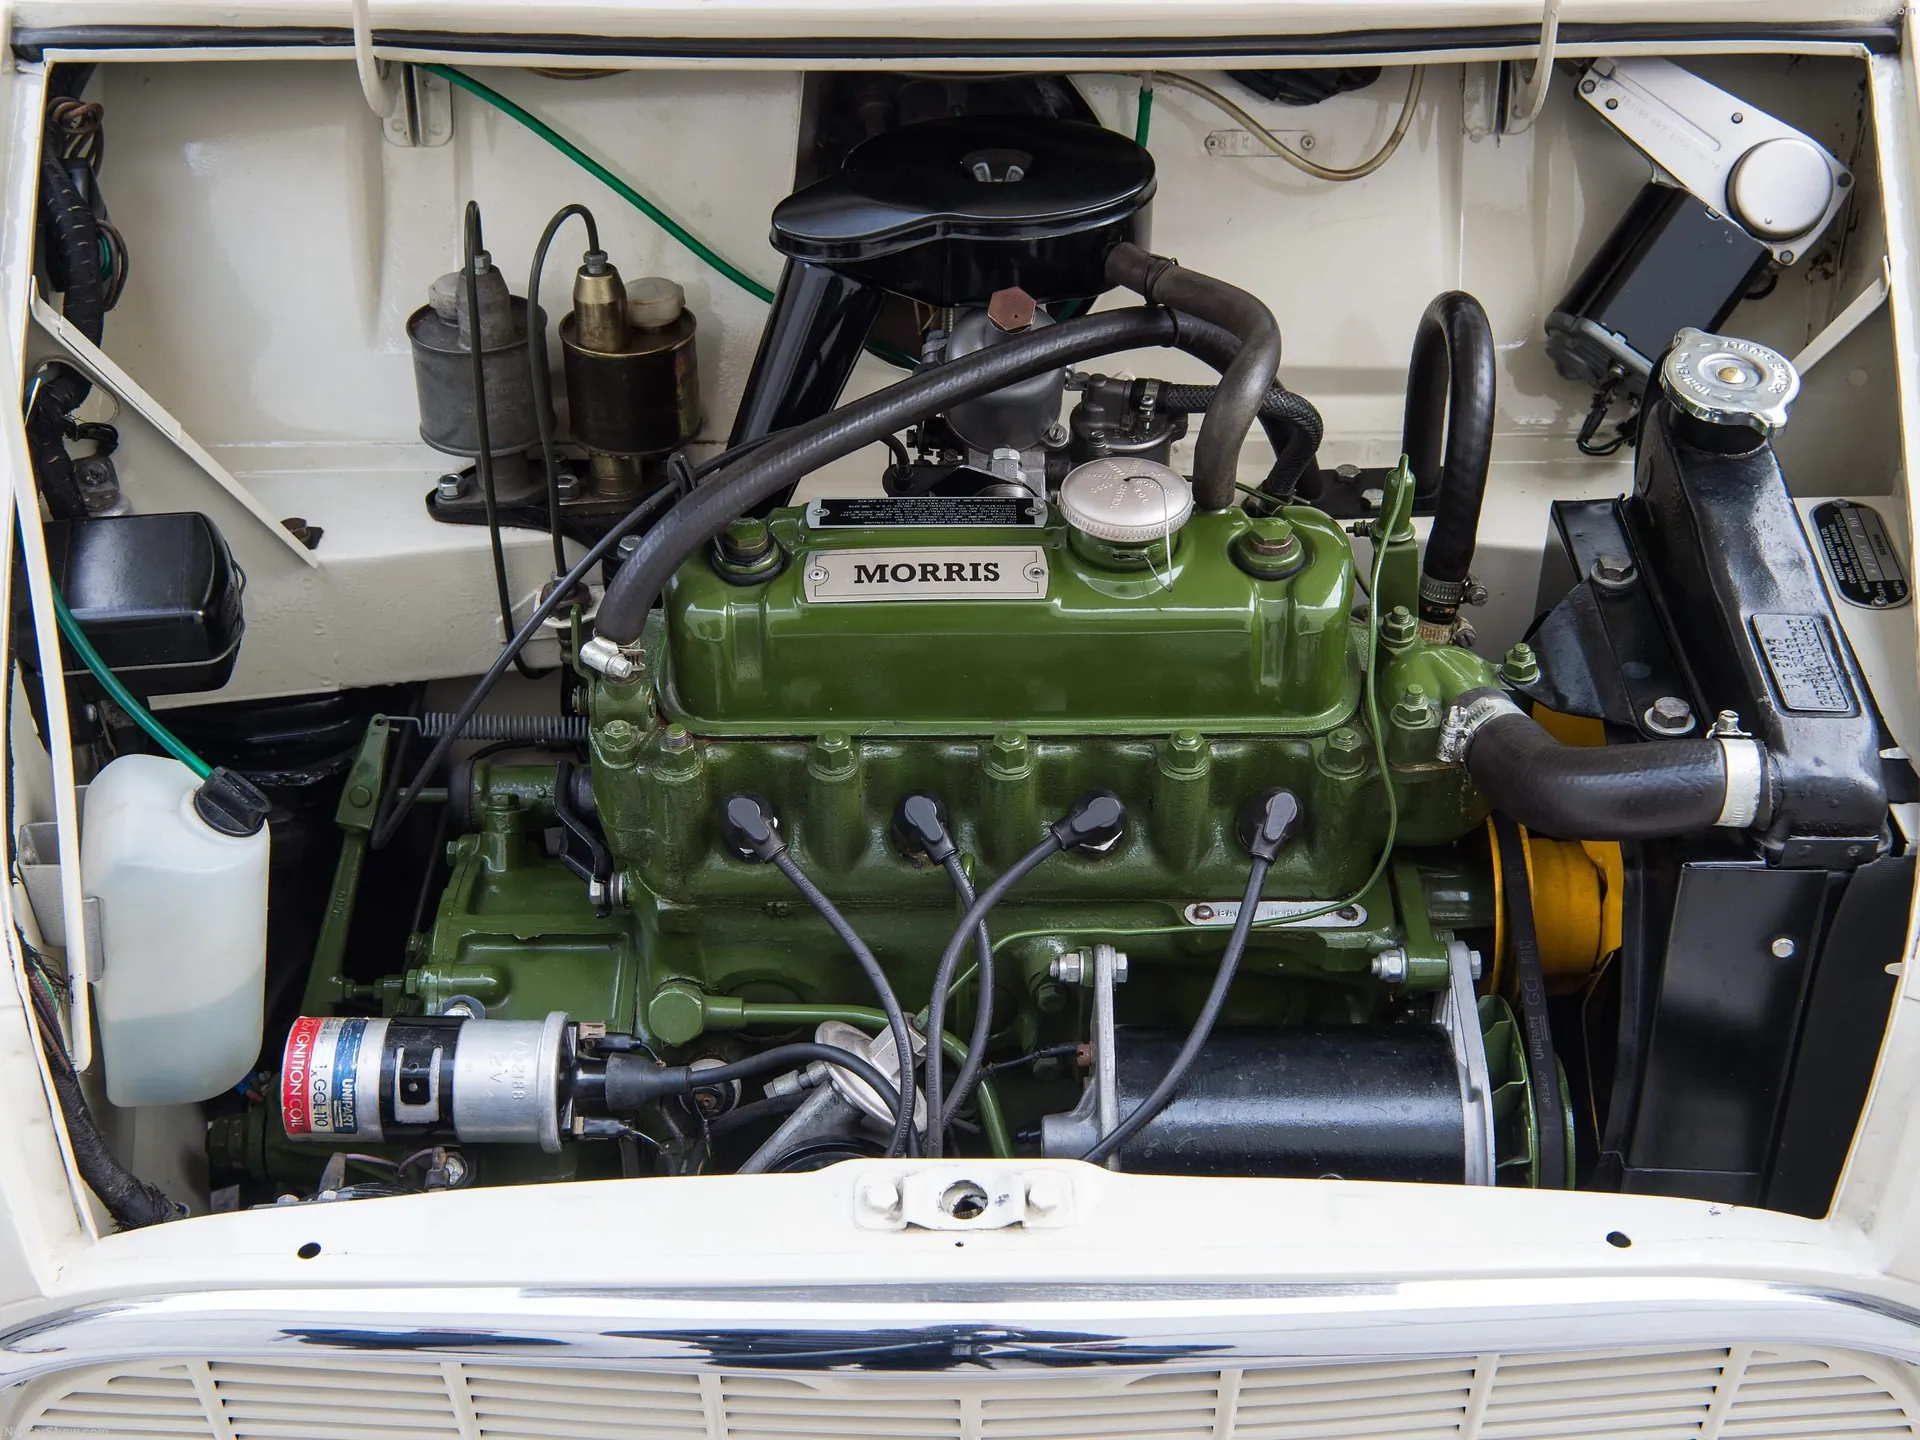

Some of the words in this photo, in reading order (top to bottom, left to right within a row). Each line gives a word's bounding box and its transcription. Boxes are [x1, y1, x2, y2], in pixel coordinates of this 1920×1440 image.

[853, 562, 1000, 584] MORRIS
[899, 1034, 911, 1065] CABLE
[1528, 1015, 1545, 1060] UNIPART
[290, 1031, 311, 1096] IGNITION
[290, 1099, 304, 1128] COIL
[342, 1077, 355, 1128] UNIPART
[900, 1070, 912, 1138] SUPPRESSOR
